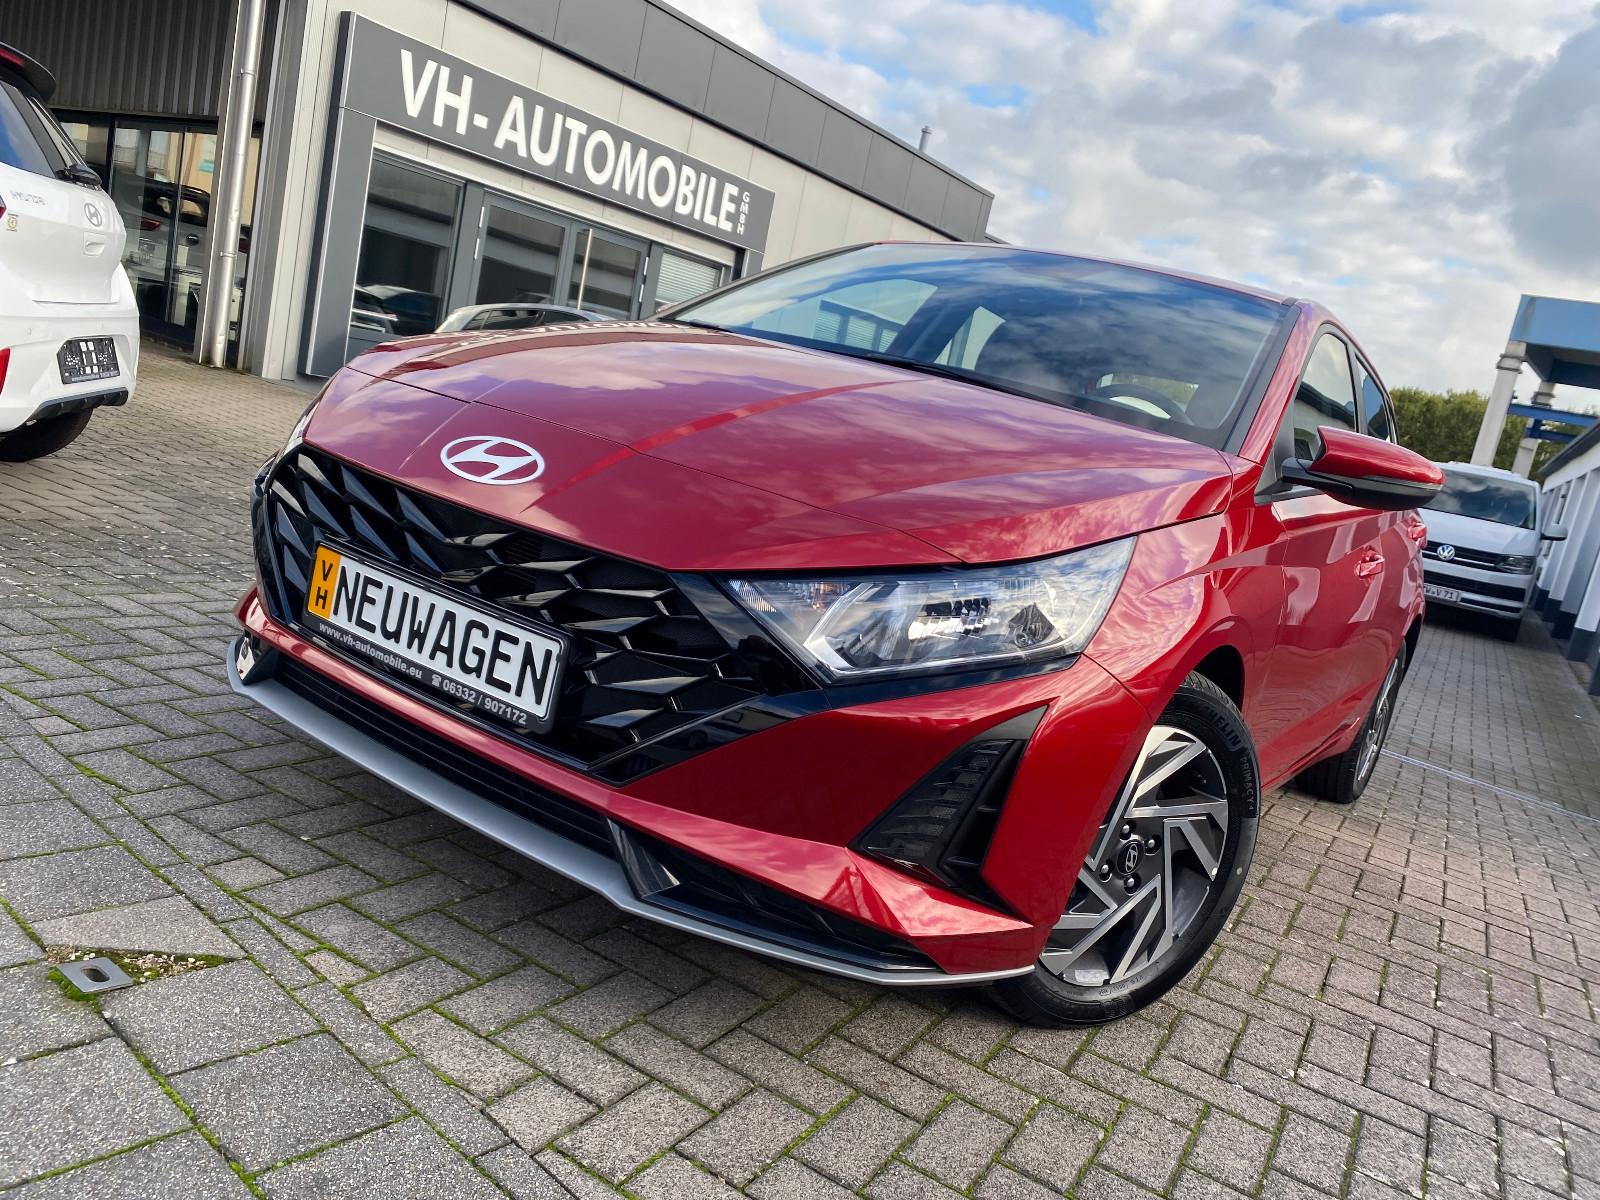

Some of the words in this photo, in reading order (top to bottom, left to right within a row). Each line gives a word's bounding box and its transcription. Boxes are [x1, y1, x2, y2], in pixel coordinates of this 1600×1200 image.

[737, 191, 750, 235] GMBH
[319, 622, 423, 679] www.vh-automobile.eu
[333, 565, 552, 705] NEUWAGEN
[443, 680, 476, 703] 06332
[484, 698, 528, 725] 907172
